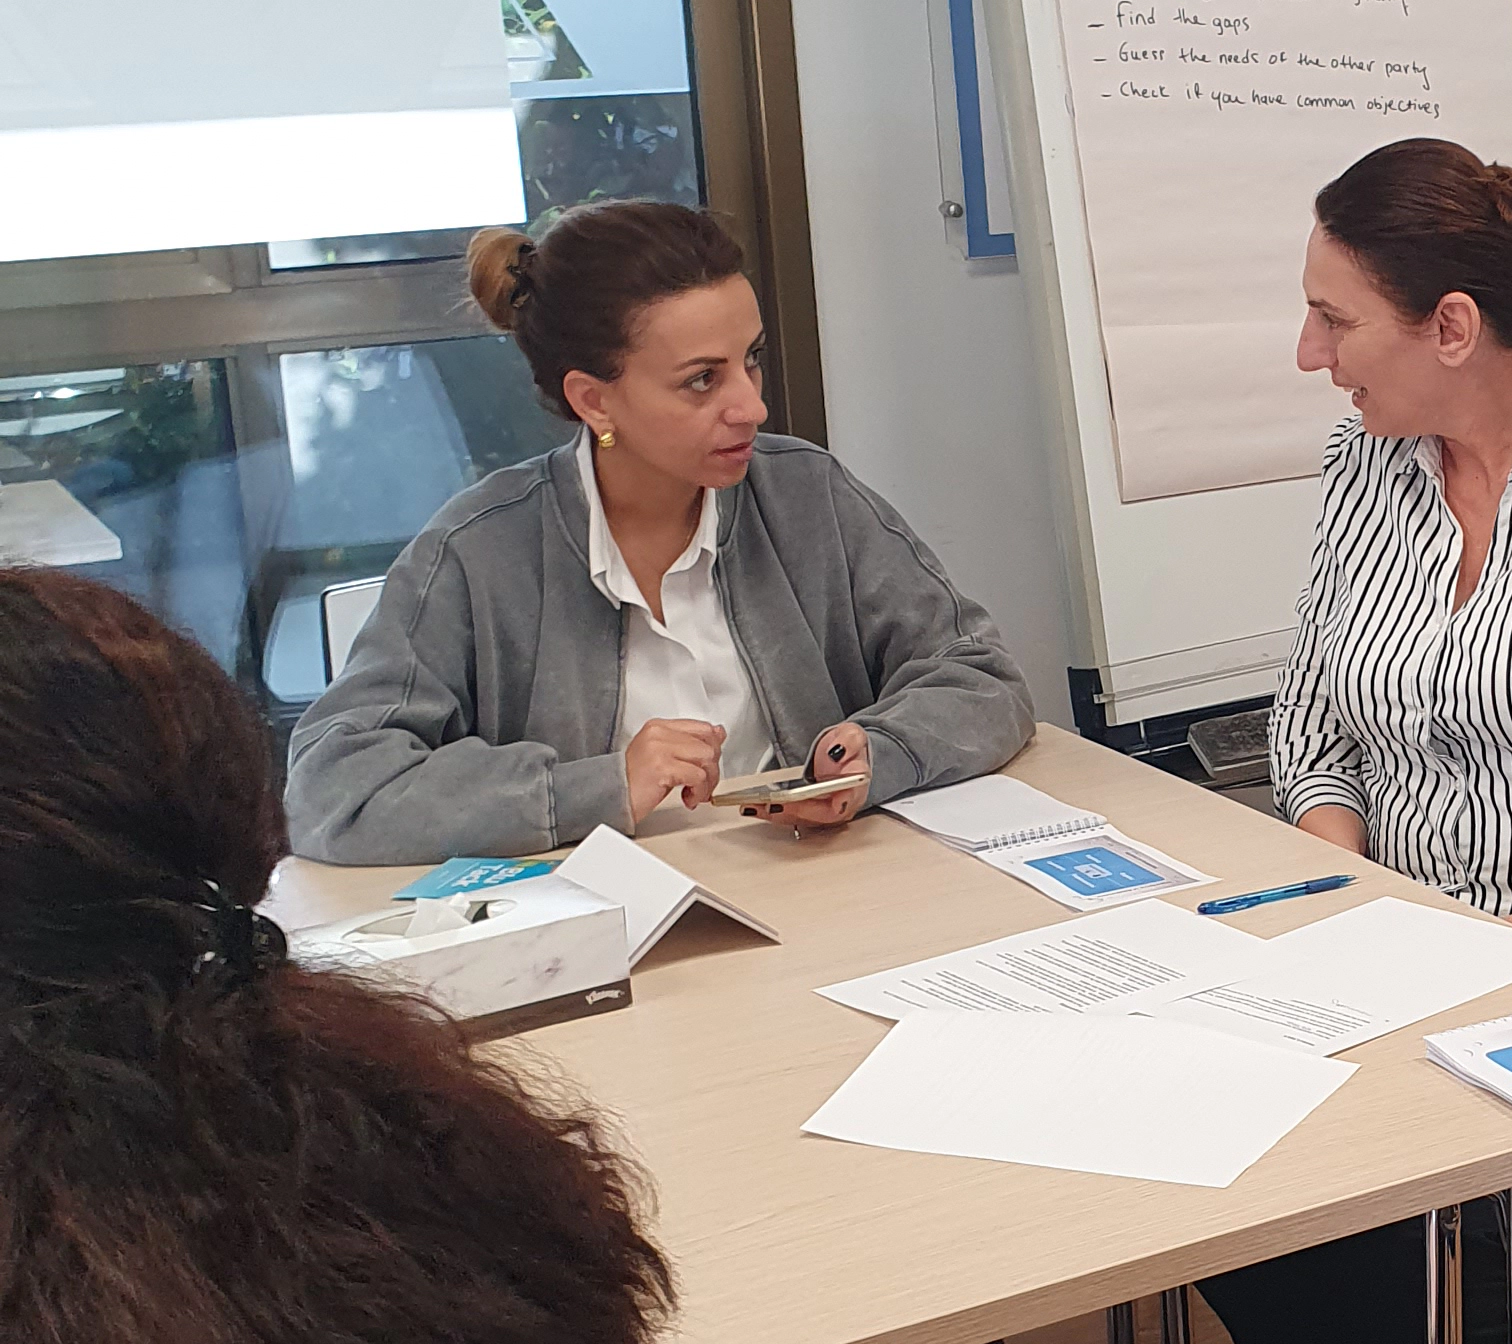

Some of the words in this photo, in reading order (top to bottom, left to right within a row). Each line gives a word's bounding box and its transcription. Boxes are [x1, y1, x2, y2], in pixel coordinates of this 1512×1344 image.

[1173, 7, 1207, 26] the
[1212, 17, 1250, 36] gaps
[1118, 41, 1166, 63] Guess
[1178, 47, 1212, 64] the
[1218, 49, 1260, 65] needs
[1268, 51, 1288, 65] of
[1297, 52, 1327, 68] the
[1330, 54, 1376, 73] other
[1385, 61, 1431, 91] party
[1119, 81, 1171, 99] Check
[1185, 82, 1204, 100] if
[1211, 90, 1247, 112] you
[1252, 88, 1288, 106] have
[1296, 94, 1356, 111] common
[1366, 95, 1440, 120] objectives
